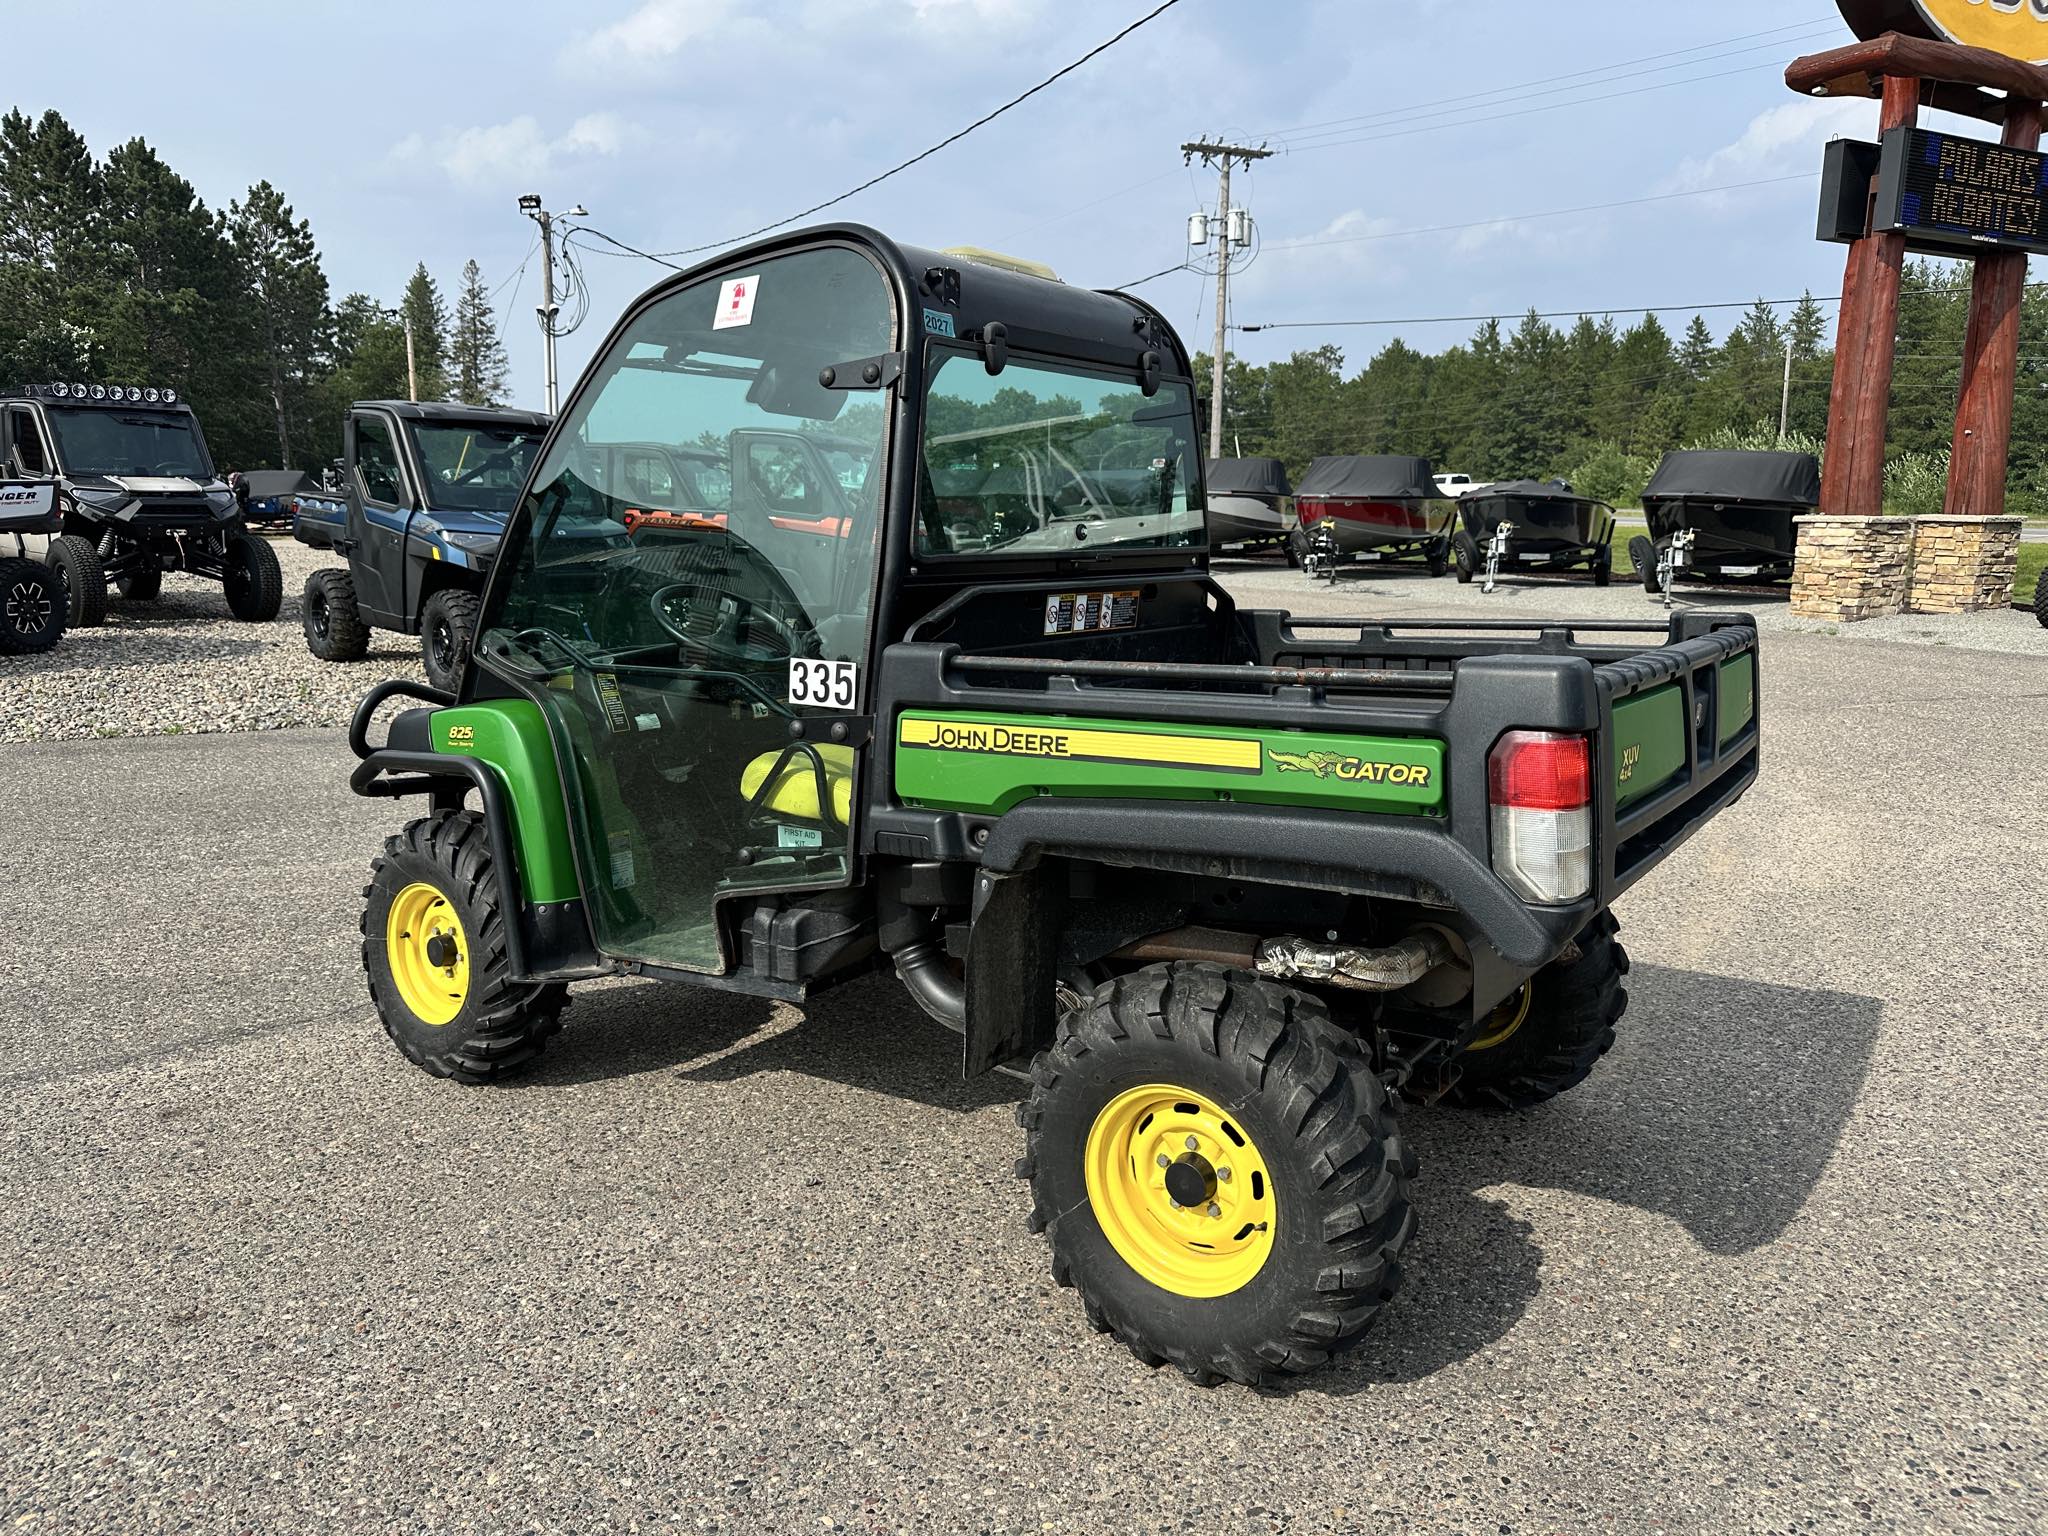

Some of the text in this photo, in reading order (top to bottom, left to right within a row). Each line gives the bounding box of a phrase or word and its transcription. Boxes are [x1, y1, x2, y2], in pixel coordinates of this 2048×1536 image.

[1938, 141, 2040, 195] POLARIS
[925, 315, 949, 333] 2027
[792, 661, 853, 706] 335
[449, 726, 474, 739] 825i
[929, 724, 1069, 753] JOHN DEERE
[1622, 744, 1640, 767] XUV
[1335, 756, 1431, 786] GATOR
[784, 828, 816, 839] FIRST AID
